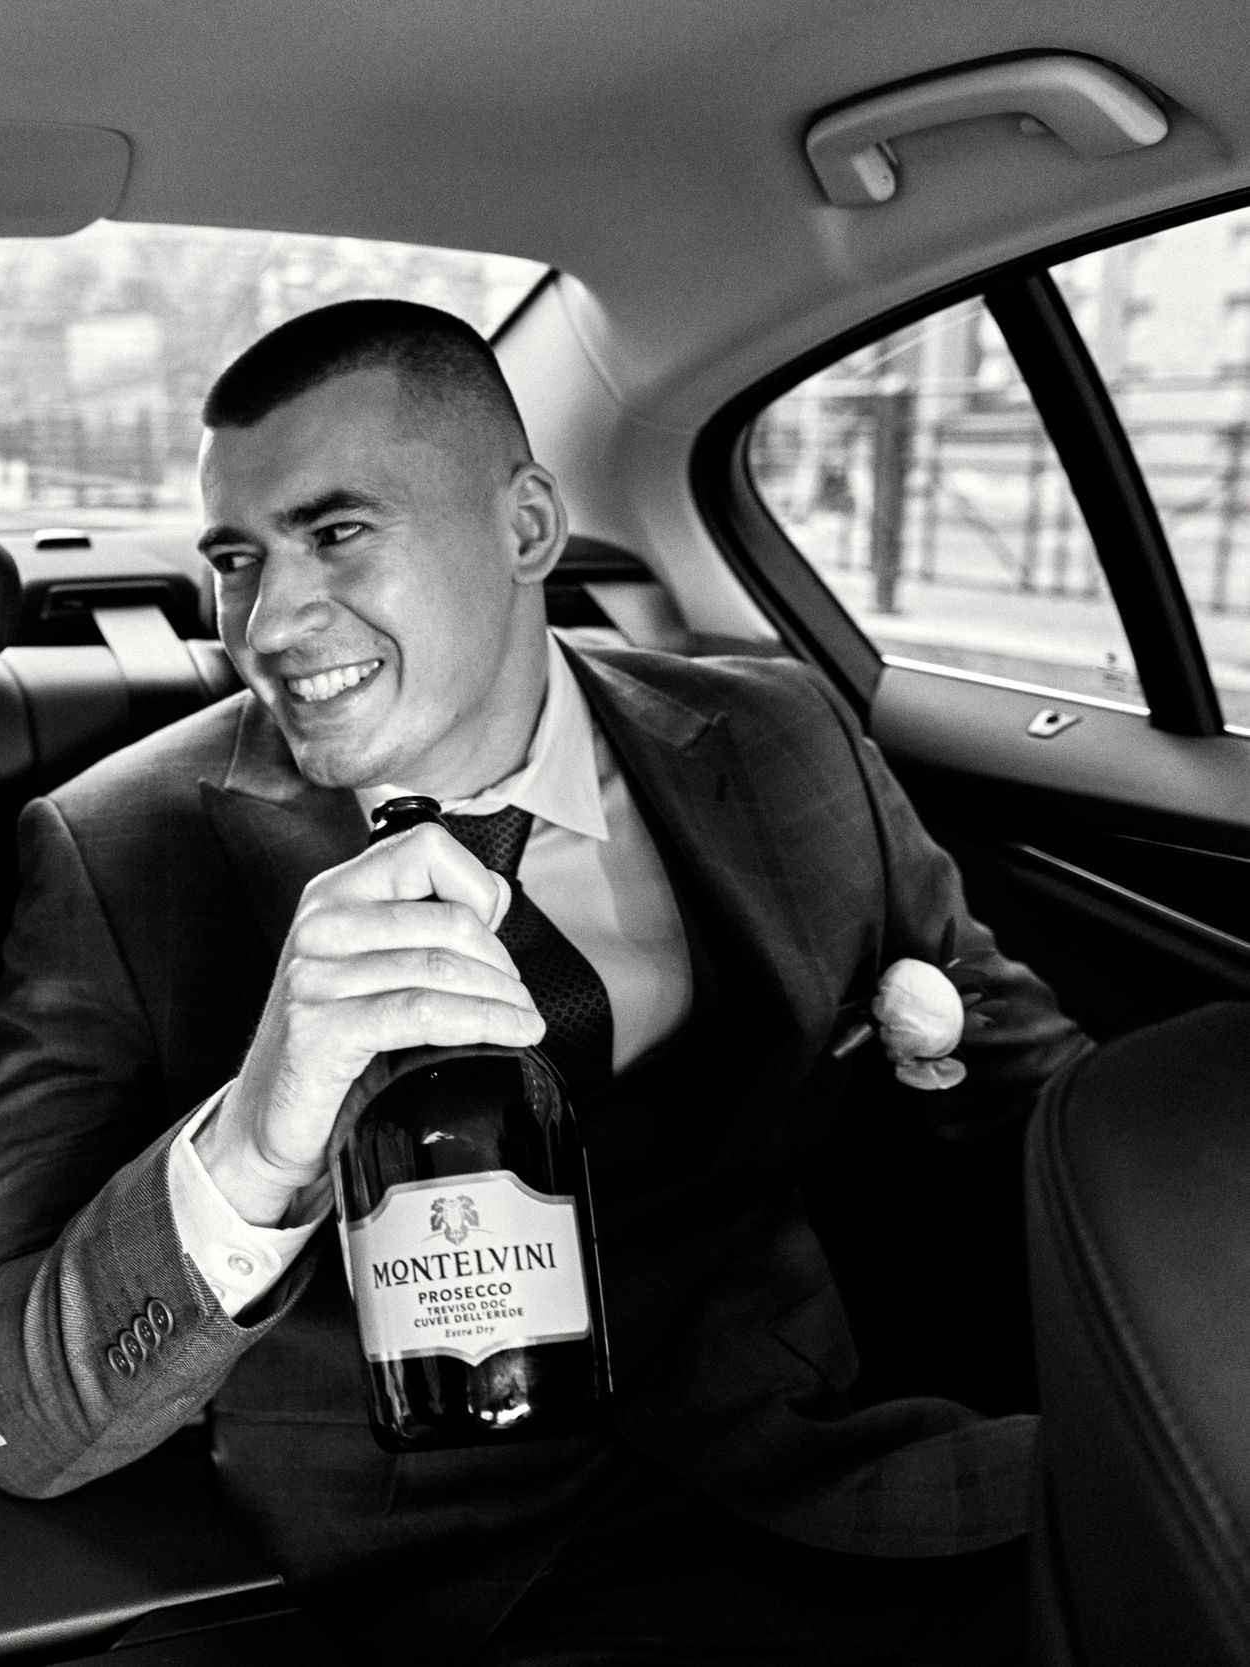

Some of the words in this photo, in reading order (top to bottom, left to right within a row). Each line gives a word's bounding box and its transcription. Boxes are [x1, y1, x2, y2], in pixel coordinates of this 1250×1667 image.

[372, 1242, 557, 1288] MONTELVINI
[418, 1282, 512, 1304] PROSECCO
[427, 1302, 477, 1316] TREVISO
[481, 1298, 507, 1310] DOC
[454, 1307, 525, 1324] DELL'EREDE
[445, 1327, 472, 1338] Extra
[476, 1325, 495, 1336] Dry
